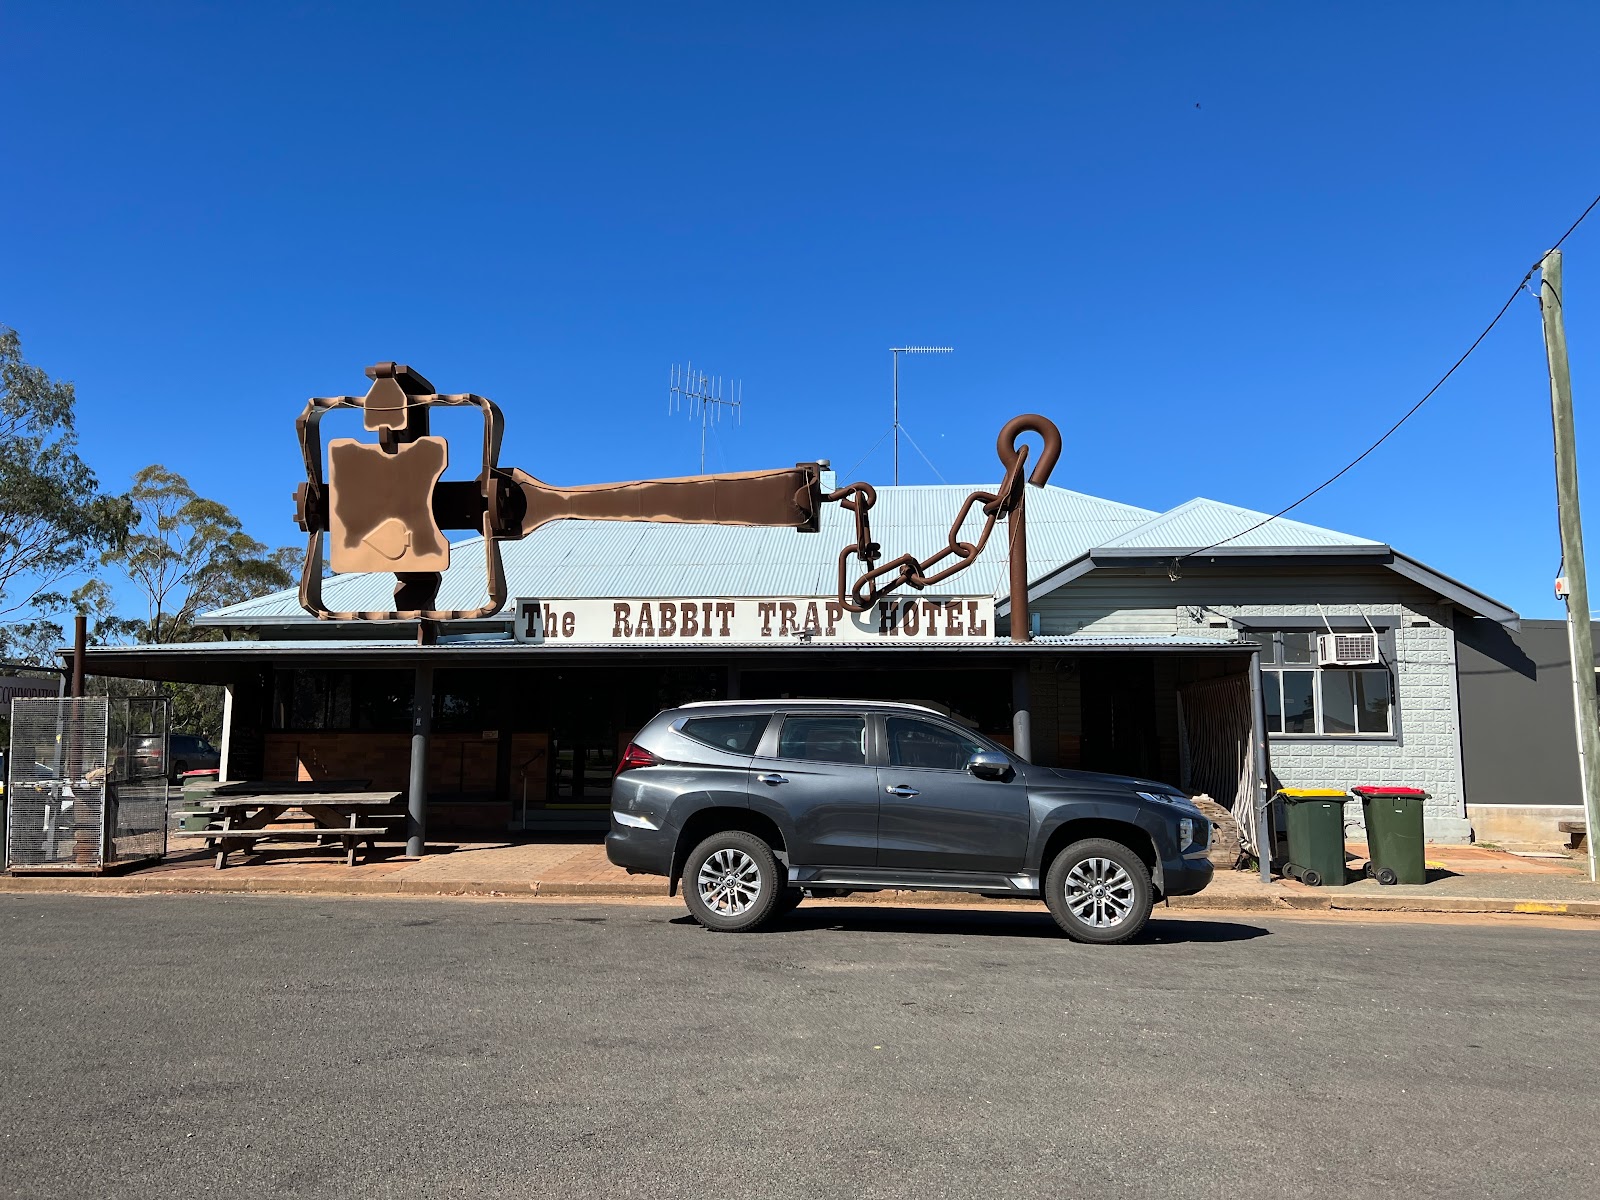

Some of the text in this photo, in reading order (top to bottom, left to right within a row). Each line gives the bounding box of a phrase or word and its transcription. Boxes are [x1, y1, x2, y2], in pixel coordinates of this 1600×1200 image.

[522, 600, 987, 638] The RABBIT TRAP HOTEL
